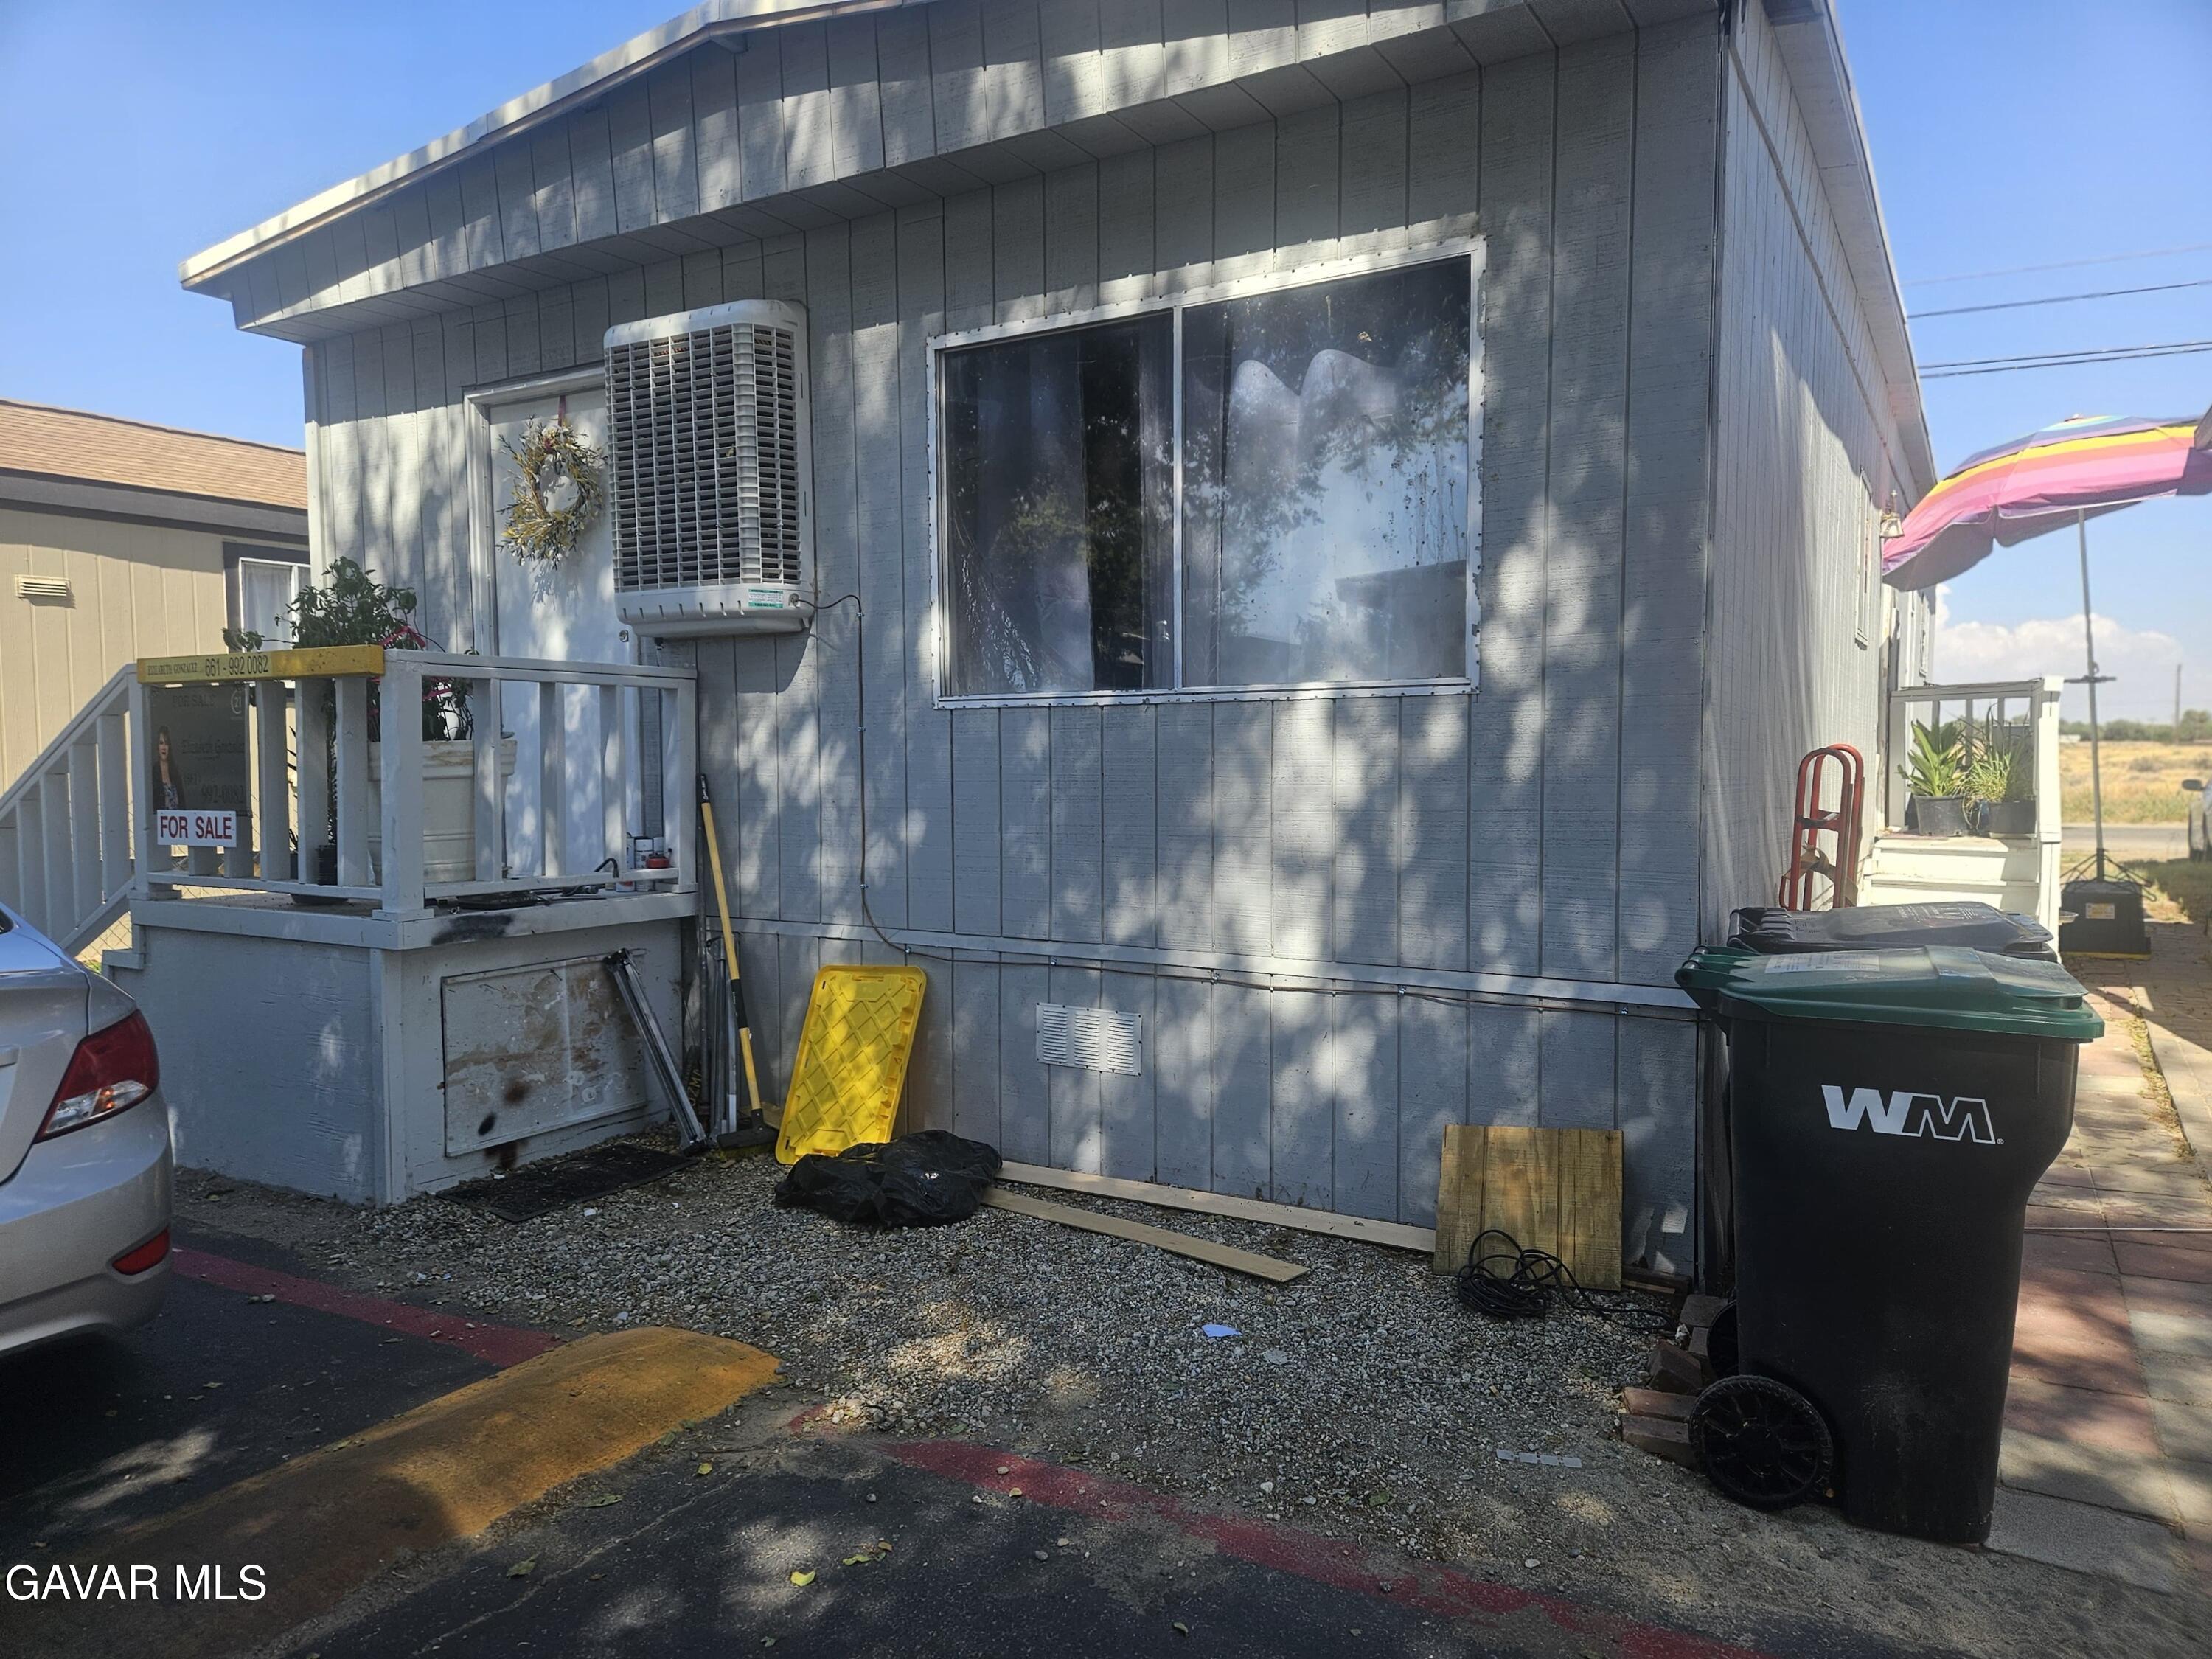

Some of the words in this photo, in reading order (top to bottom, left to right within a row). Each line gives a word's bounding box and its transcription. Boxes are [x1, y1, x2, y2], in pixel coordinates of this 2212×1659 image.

[205, 658, 220, 676] 661
[229, 656, 245, 675] 992
[248, 655, 268, 674] 0082
[172, 695, 189, 708] FOR
[160, 815, 188, 838] FOR
[195, 816, 233, 840] SALE
